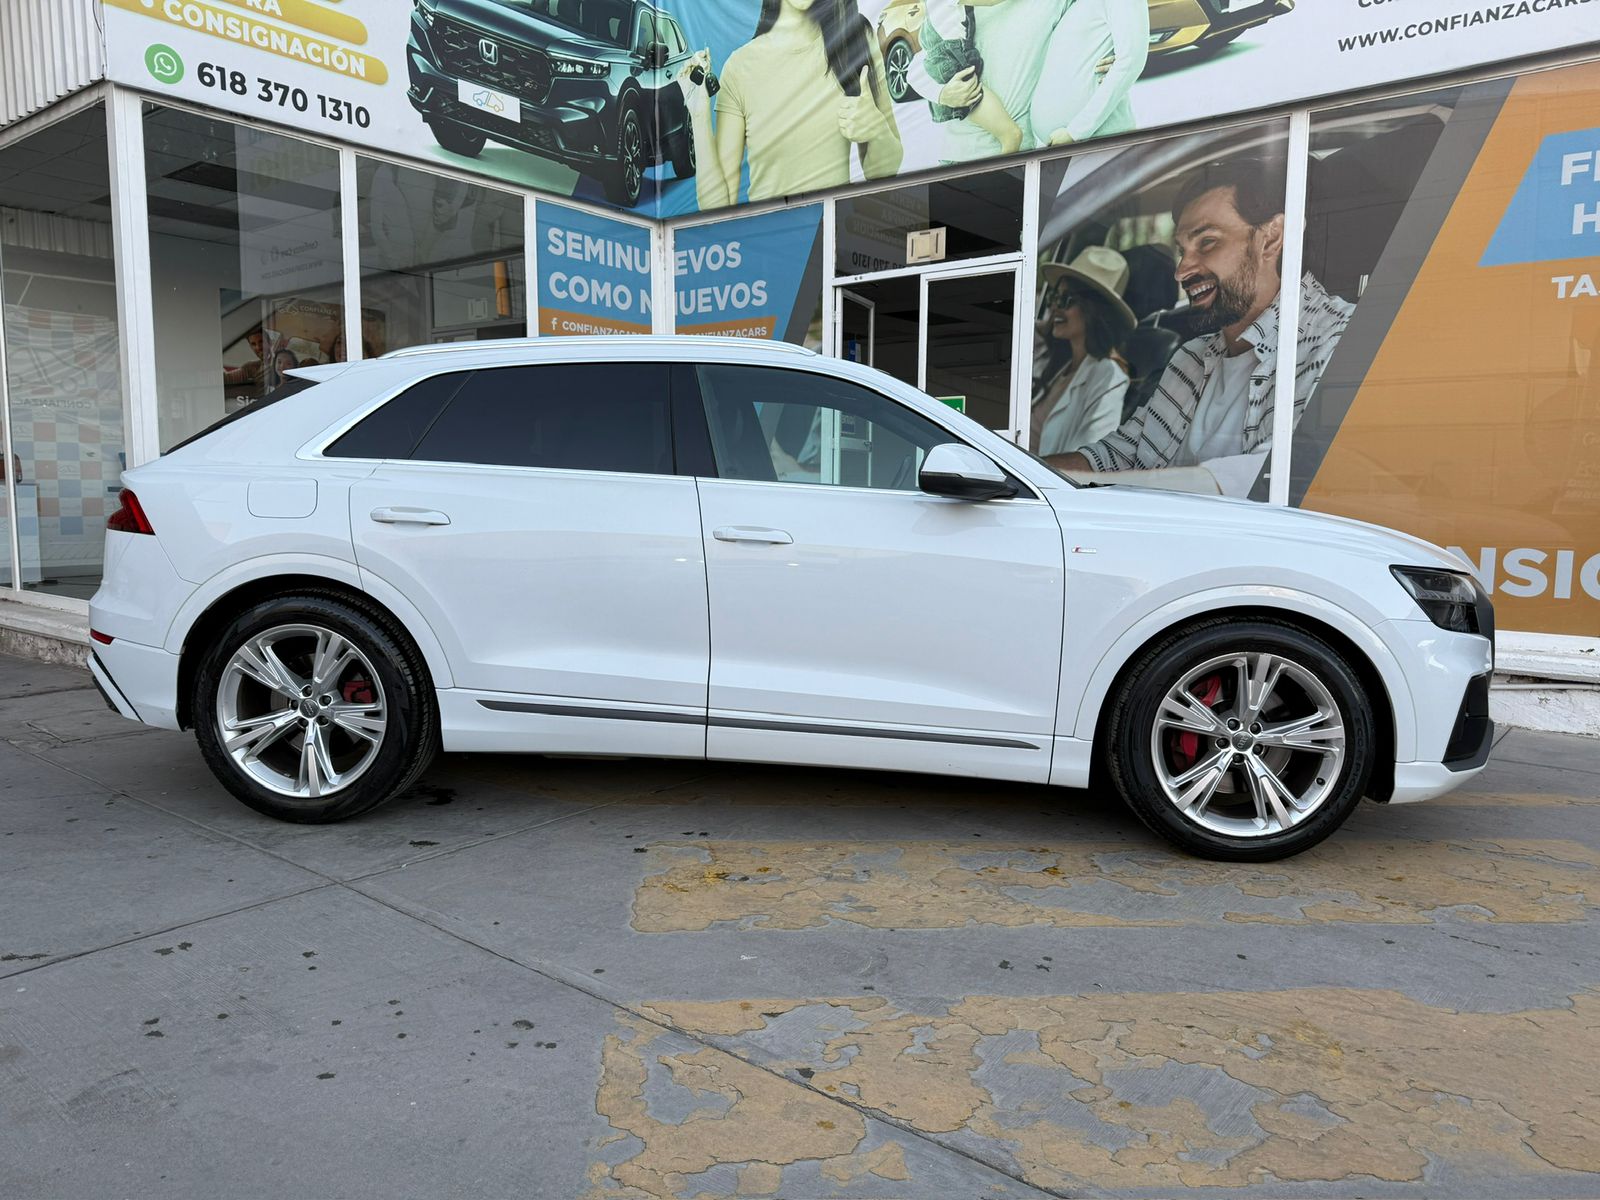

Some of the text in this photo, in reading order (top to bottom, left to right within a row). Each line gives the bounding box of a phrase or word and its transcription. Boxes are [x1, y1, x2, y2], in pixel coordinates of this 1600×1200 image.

[163, 0, 366, 78] CONSIGNACIÓN
[1337, 0, 1592, 52] WWW.CONFIANZACA
[197, 62, 370, 129] 618 370 1310
[549, 271, 632, 311] COMO
[1551, 274, 1600, 299] TA
[562, 321, 645, 335] CONFIANZA
